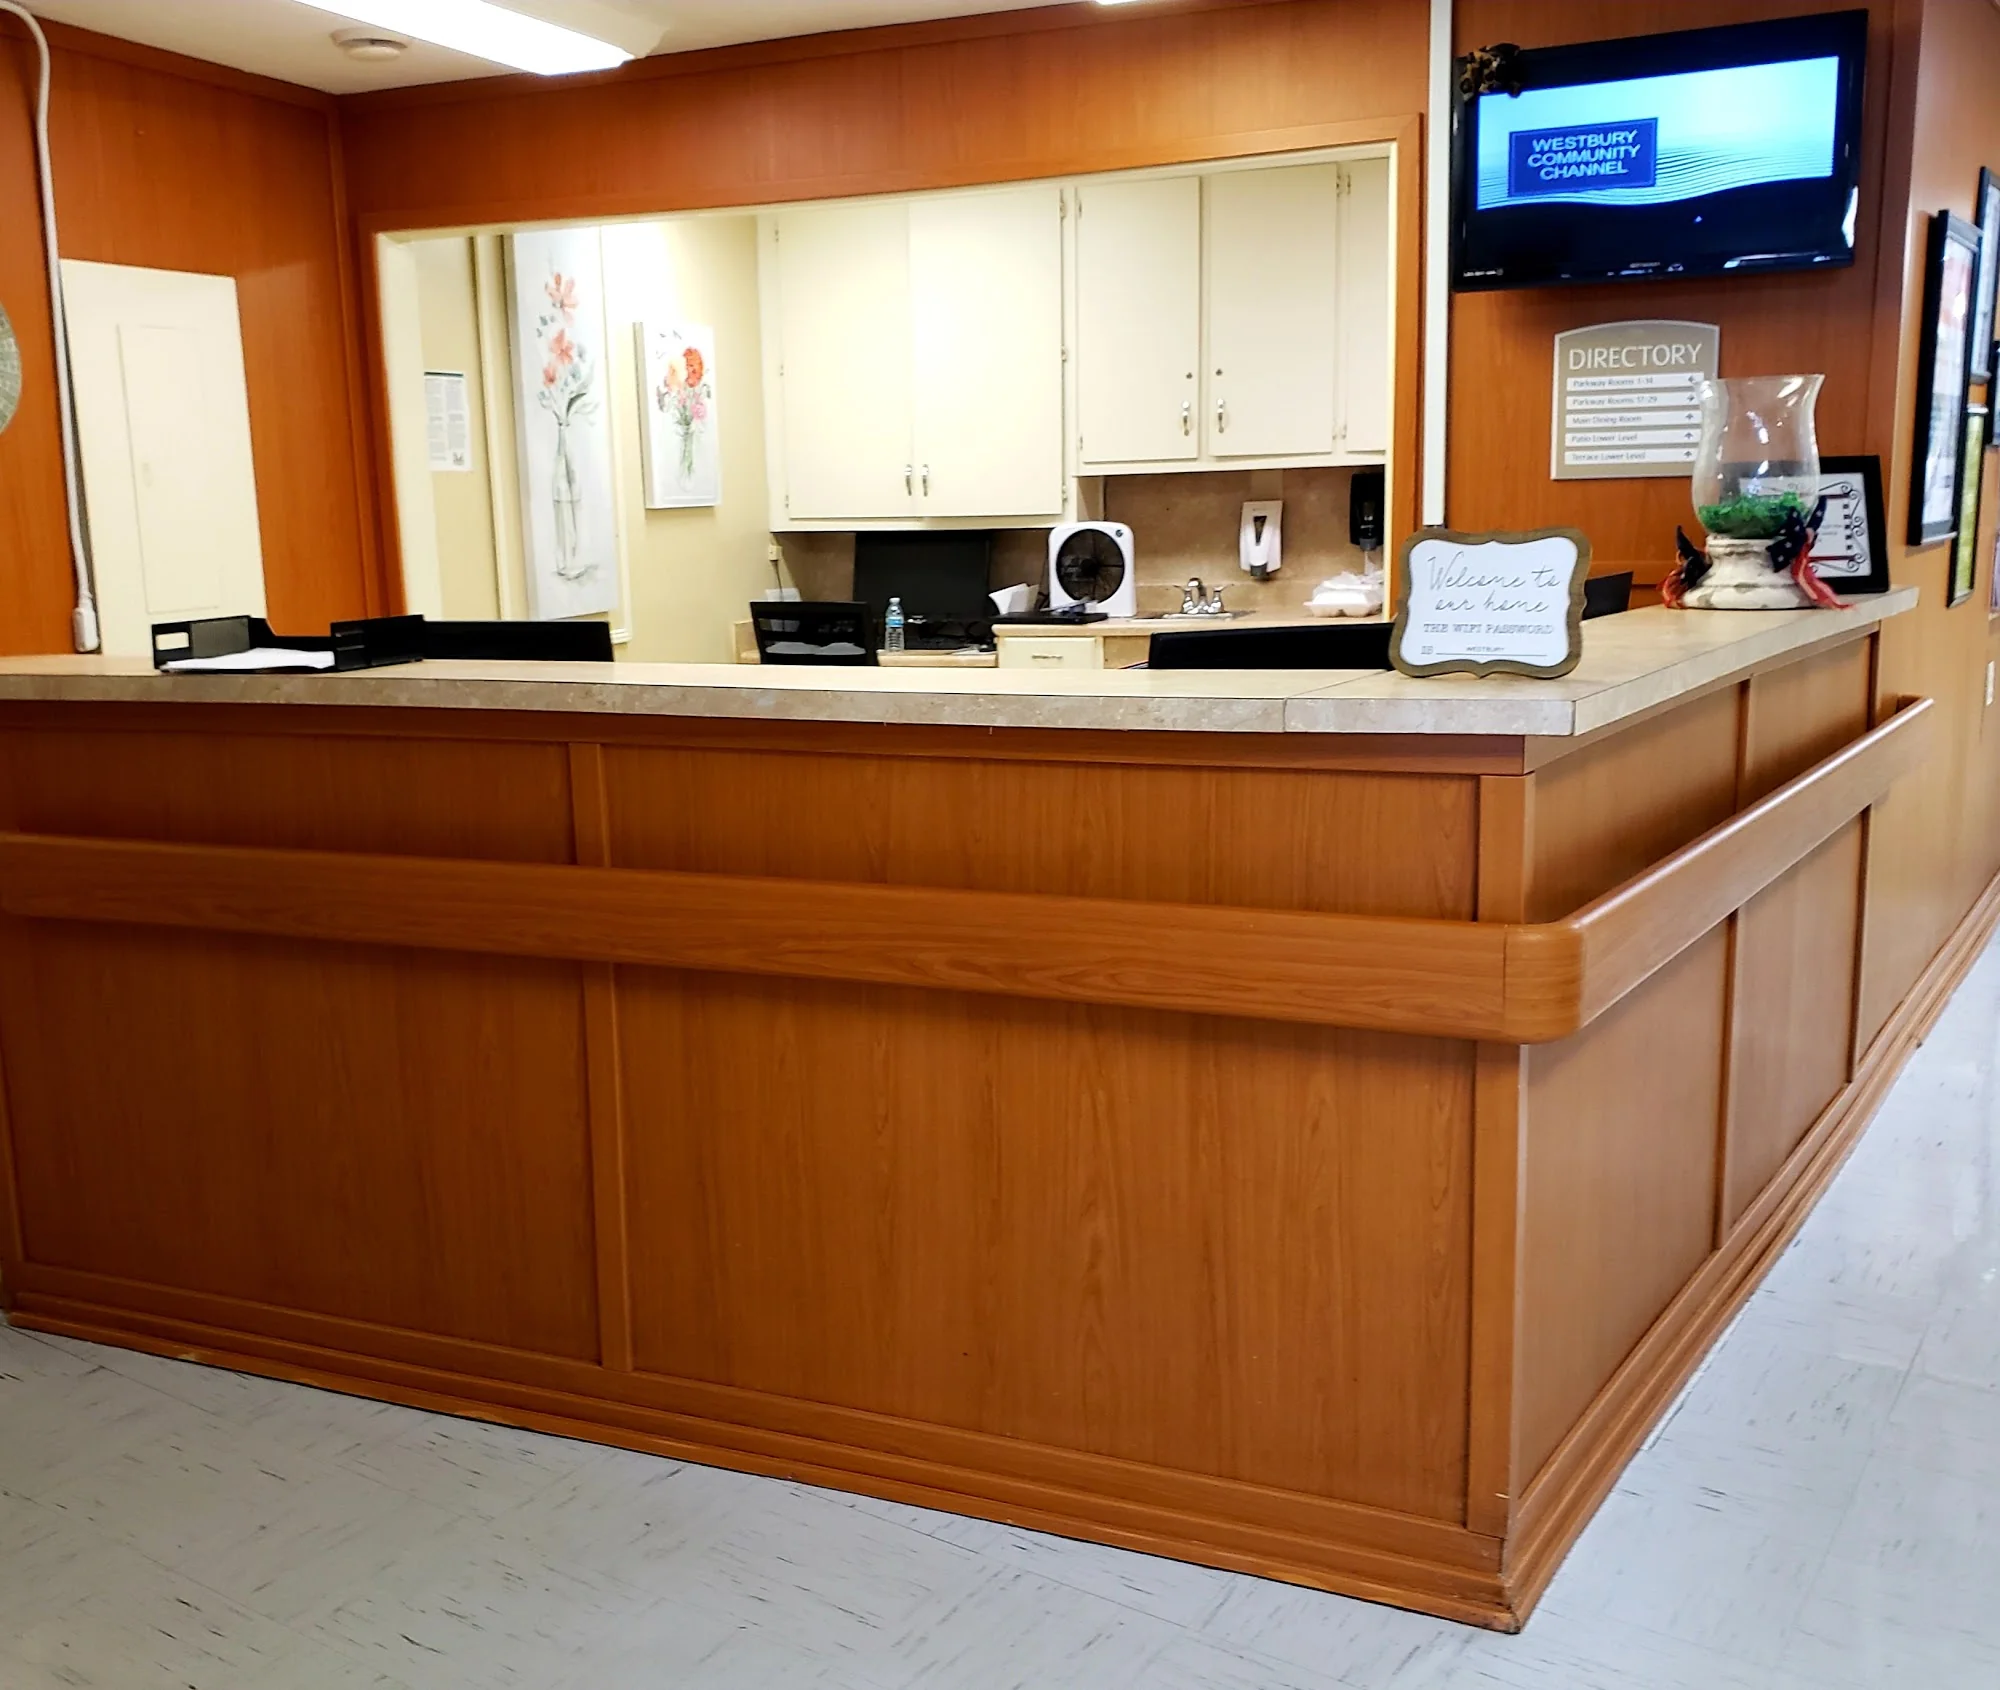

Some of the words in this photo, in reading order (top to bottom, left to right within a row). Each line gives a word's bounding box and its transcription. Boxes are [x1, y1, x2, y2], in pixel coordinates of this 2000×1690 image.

[1532, 129, 1638, 152] WESTBURY
[1527, 144, 1641, 168] COMMUNITY
[1540, 160, 1629, 181] CHANNEL
[1569, 343, 1702, 371] DIRECTORY
[1608, 378, 1634, 386] Rooms
[1608, 397, 1634, 405] Rooms
[1592, 416, 1617, 424] Dining
[1626, 451, 1646, 459] Level
[1427, 551, 1527, 591] Welcome
[1531, 566, 1561, 588] to
[1435, 598, 1476, 611] our
[1483, 590, 1549, 613] home
[1423, 623, 1449, 633] THE
[1452, 623, 1483, 634] WIFI
[1485, 624, 1554, 635] PASSWORD
